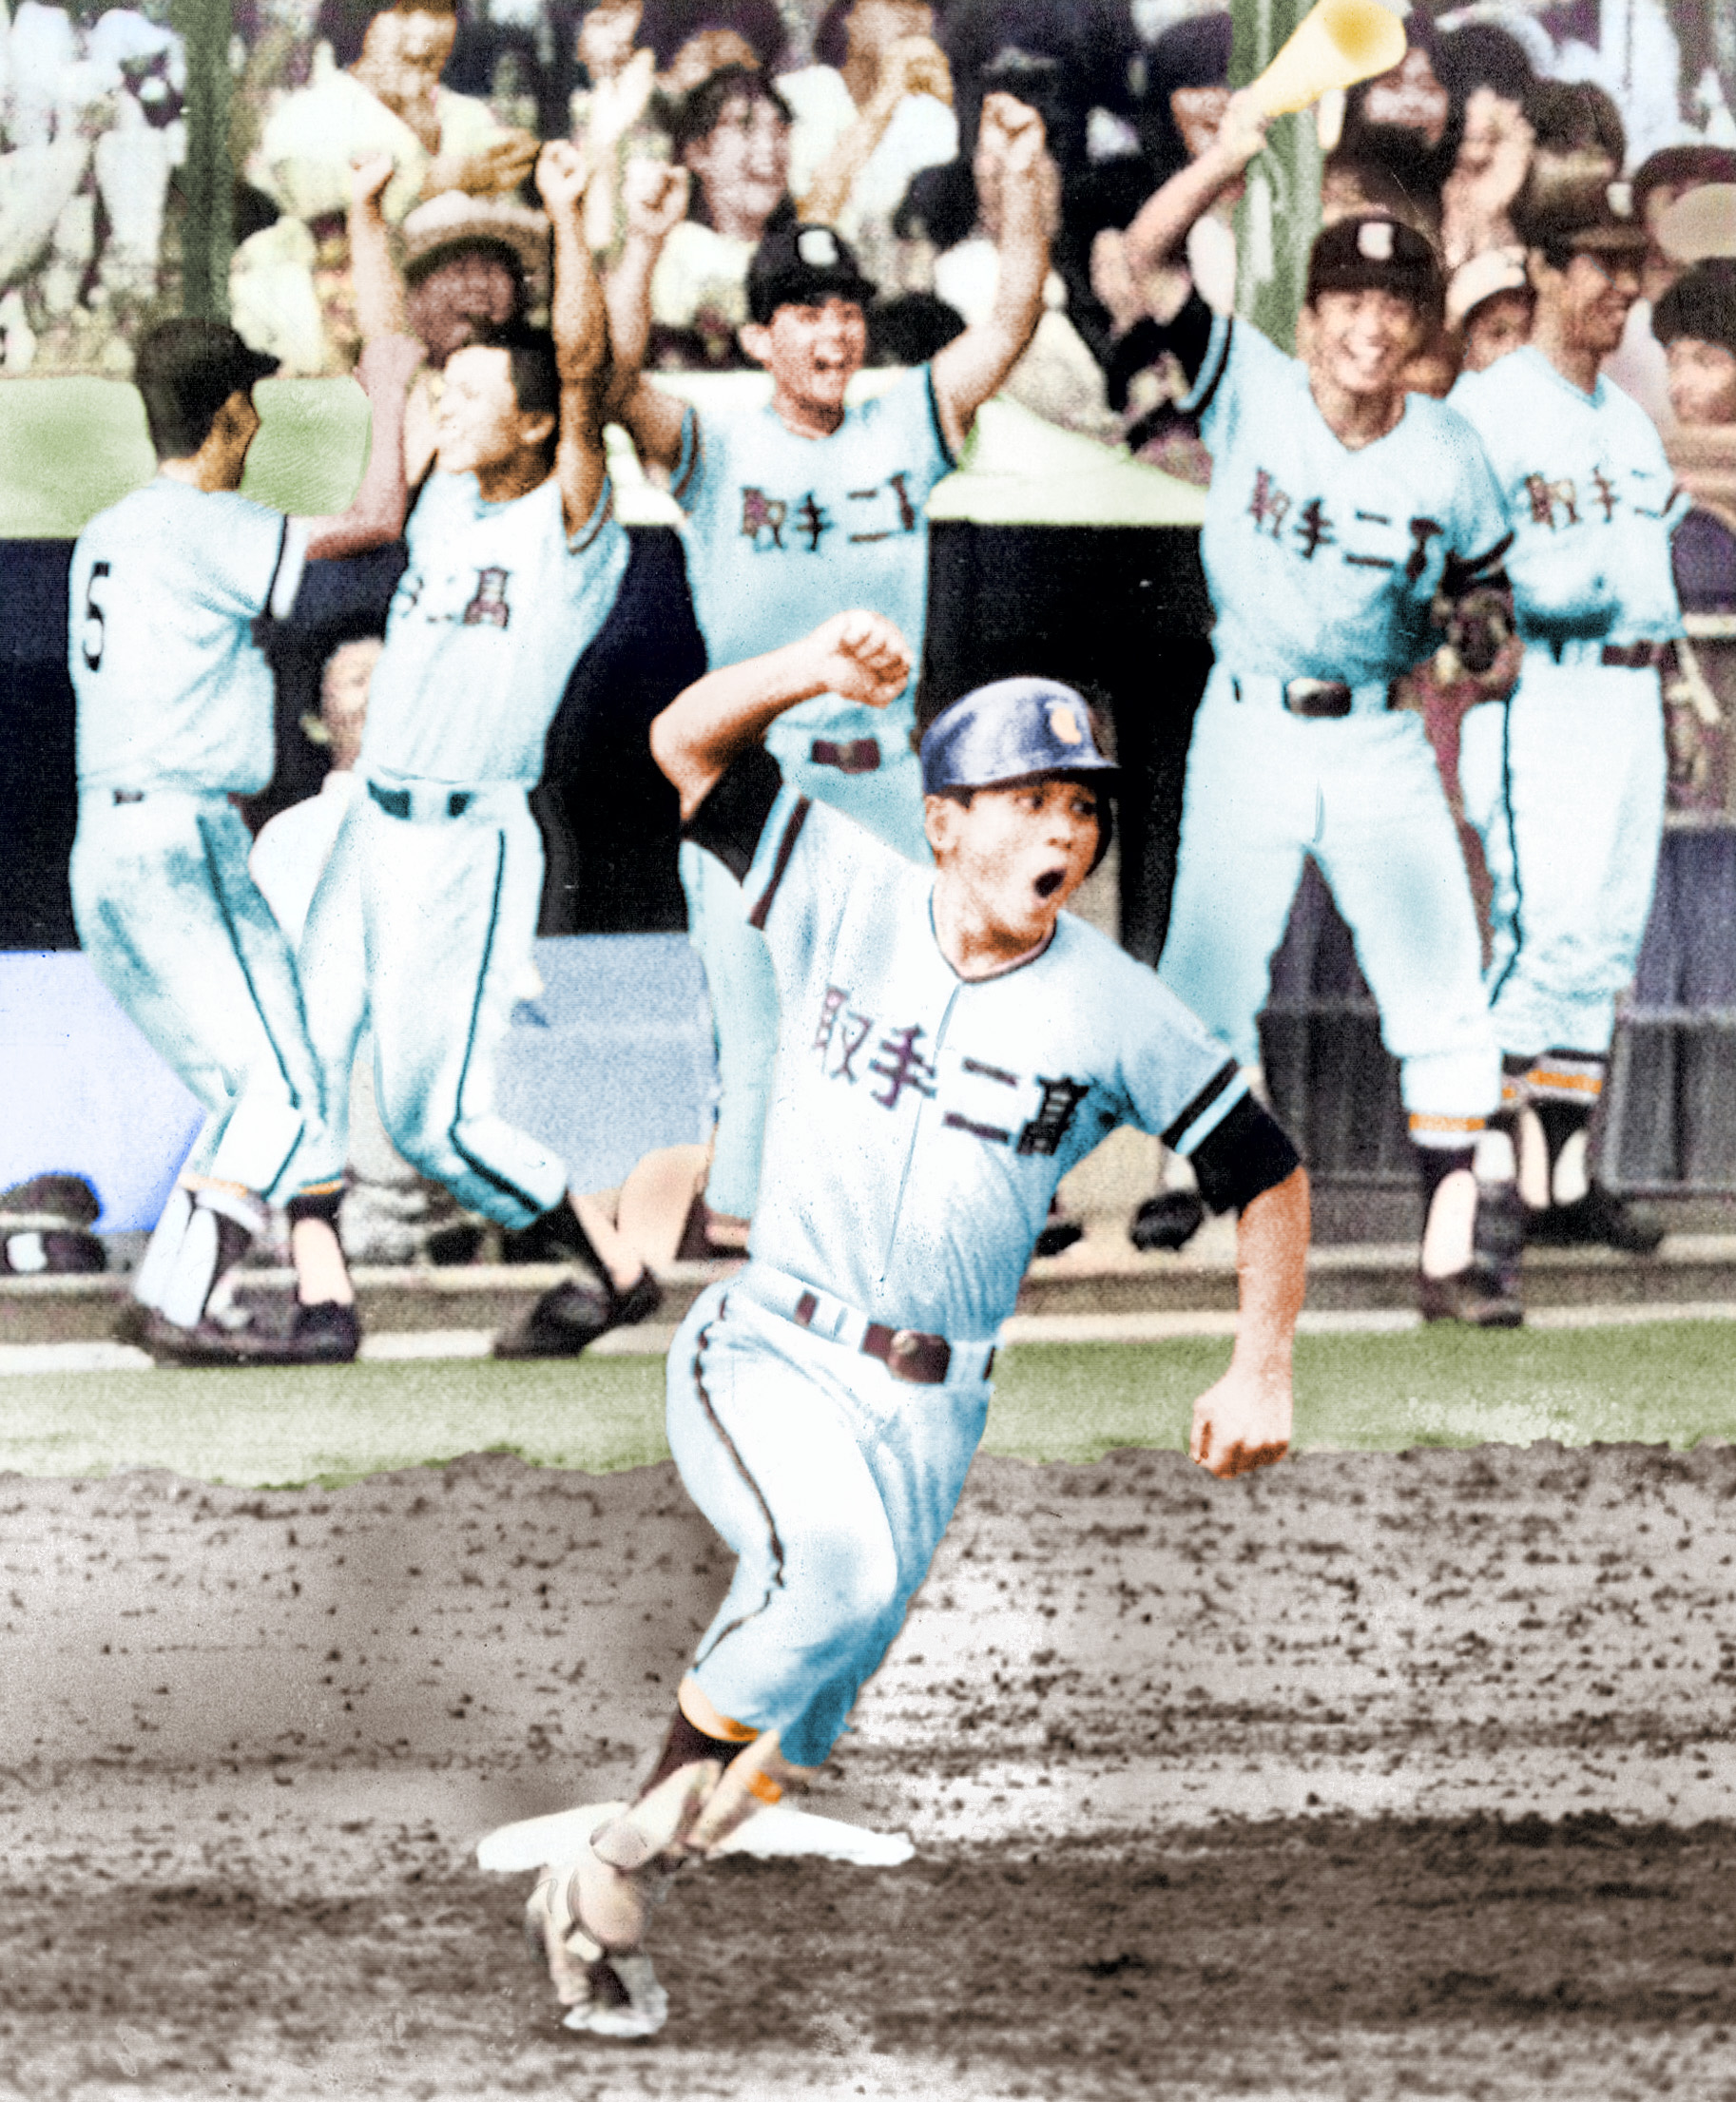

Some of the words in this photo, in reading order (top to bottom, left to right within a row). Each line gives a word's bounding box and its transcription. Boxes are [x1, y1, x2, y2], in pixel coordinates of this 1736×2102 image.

[83, 561, 110, 673] 5
[813, 984, 1090, 1157] 取手二高
